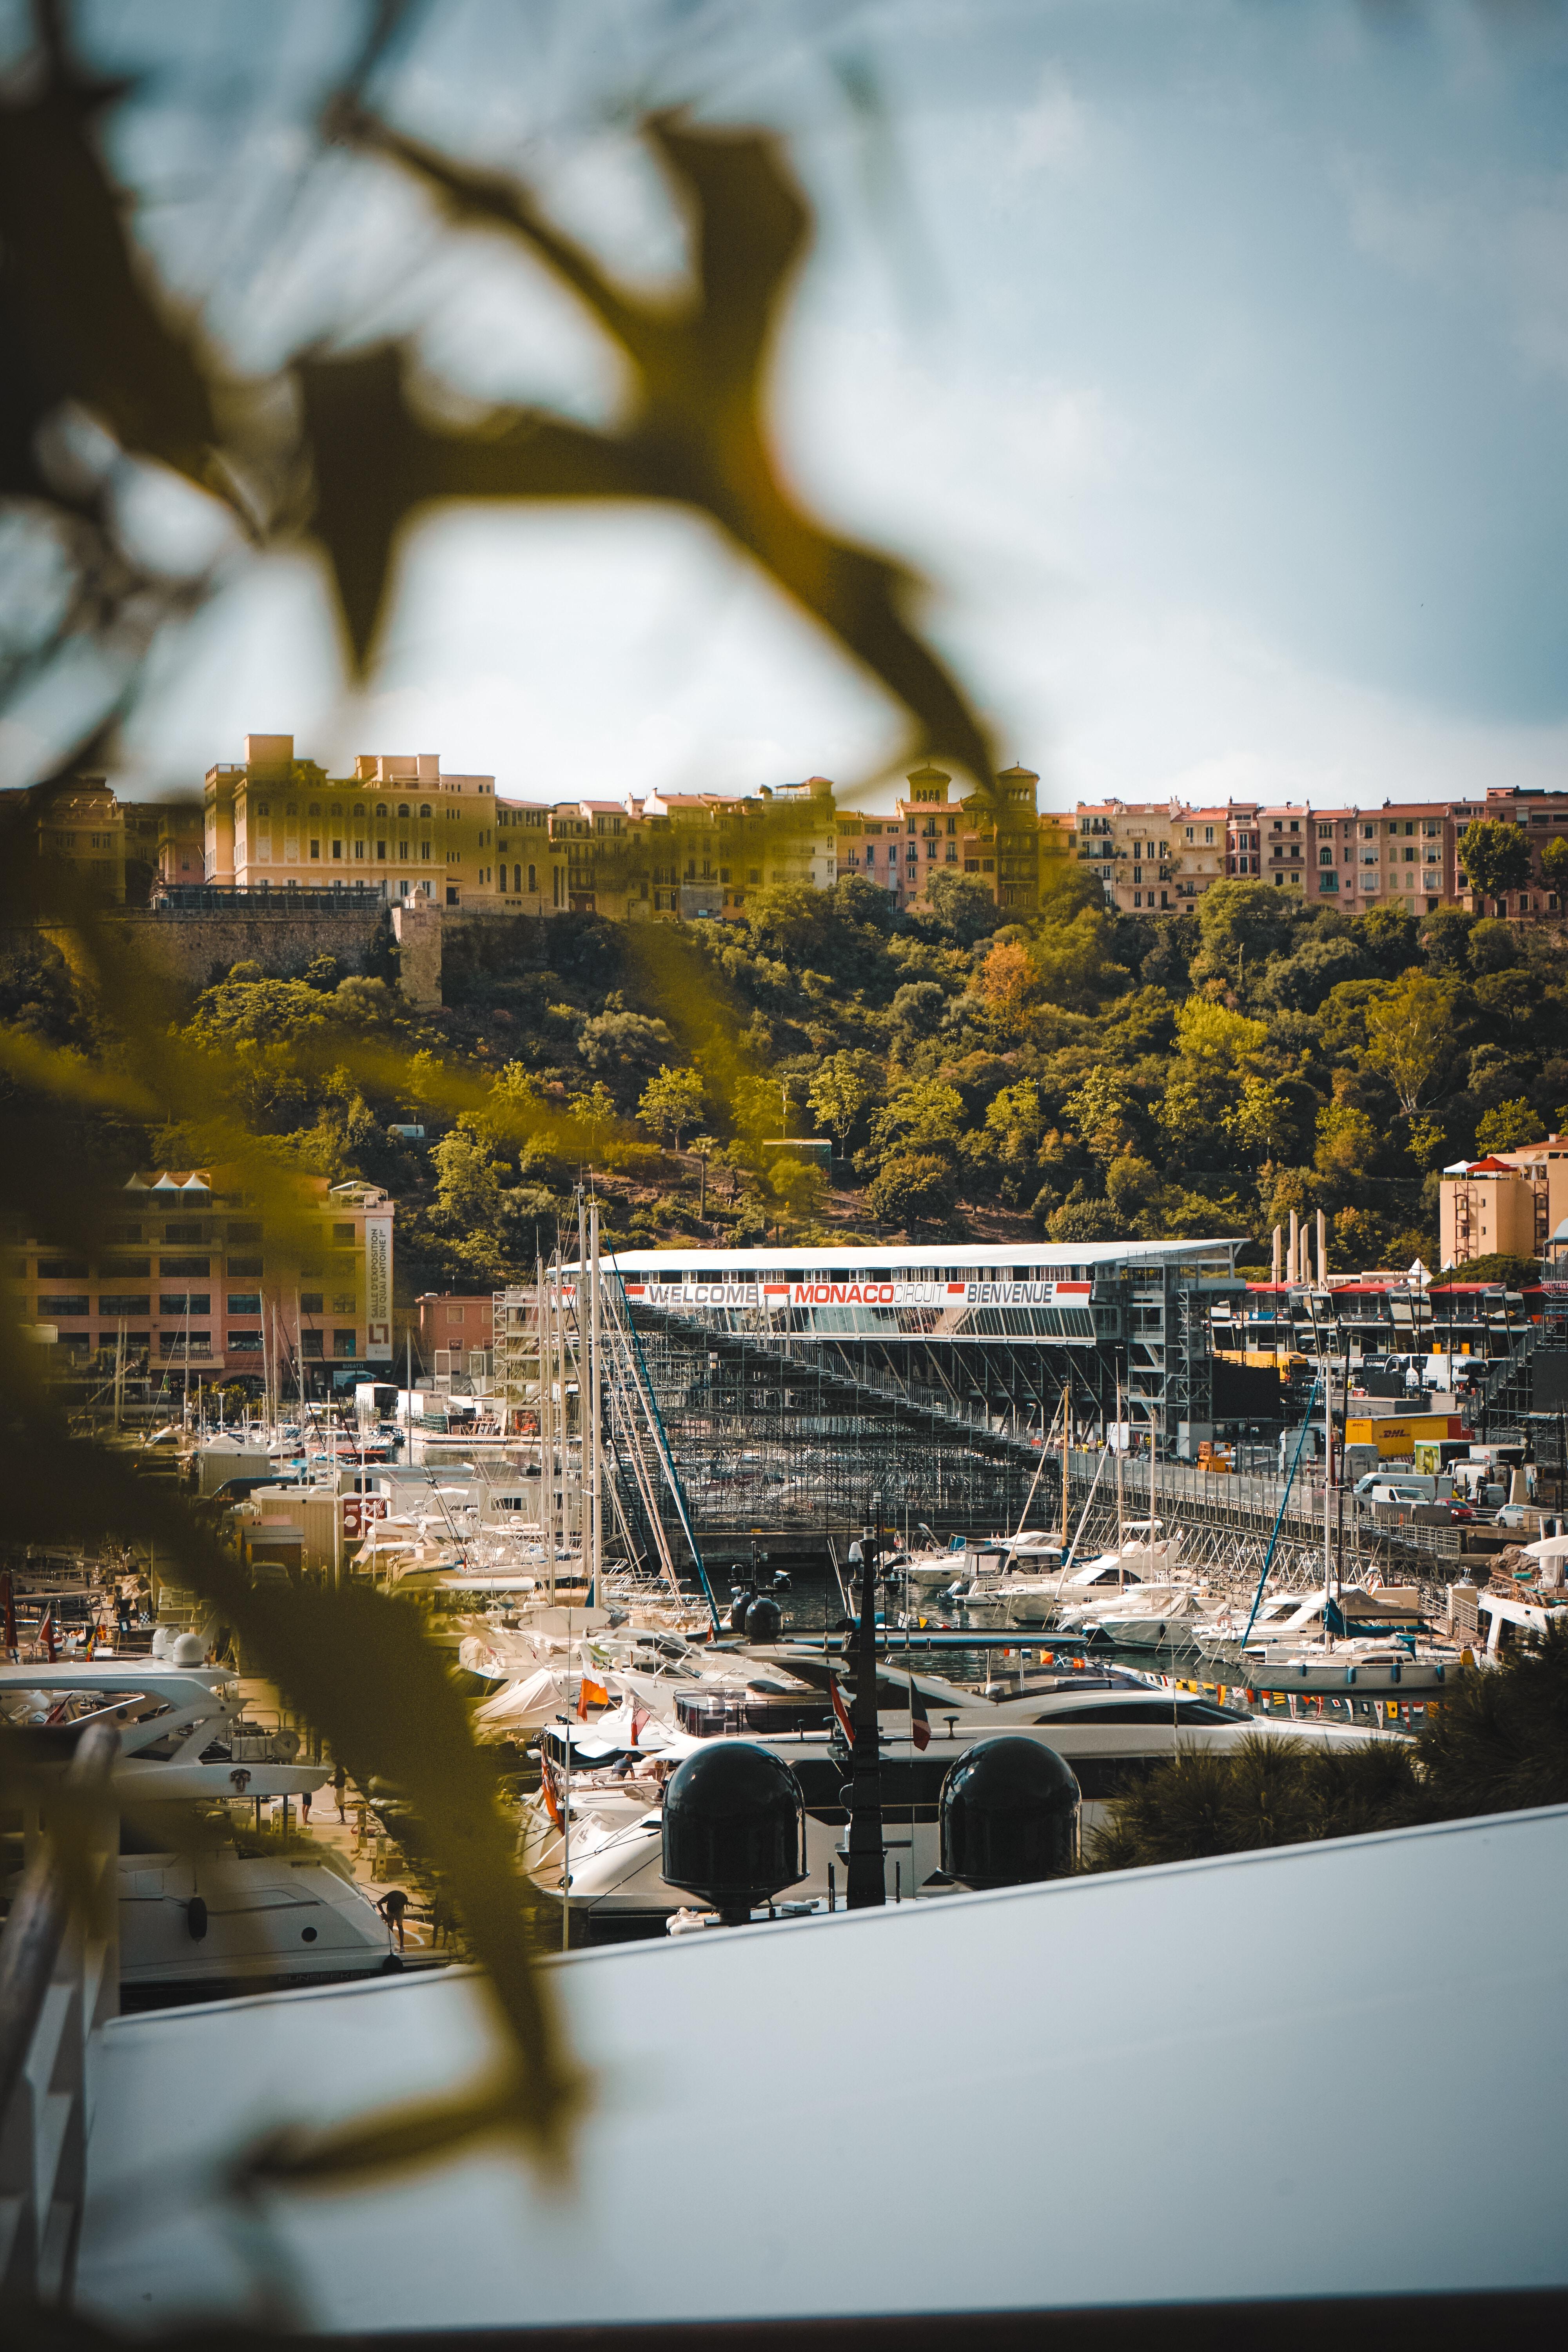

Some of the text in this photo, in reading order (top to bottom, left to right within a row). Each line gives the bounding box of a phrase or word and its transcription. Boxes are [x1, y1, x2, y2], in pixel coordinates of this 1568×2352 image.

[649, 1284, 1053, 1303] WELCOME MONACO CIRCUIT BIENVENUE
[379, 1305, 386, 1318] DU
[1383, 1429, 1406, 1438] DHL
[278, 1971, 371, 1983] SUNSEEKER
